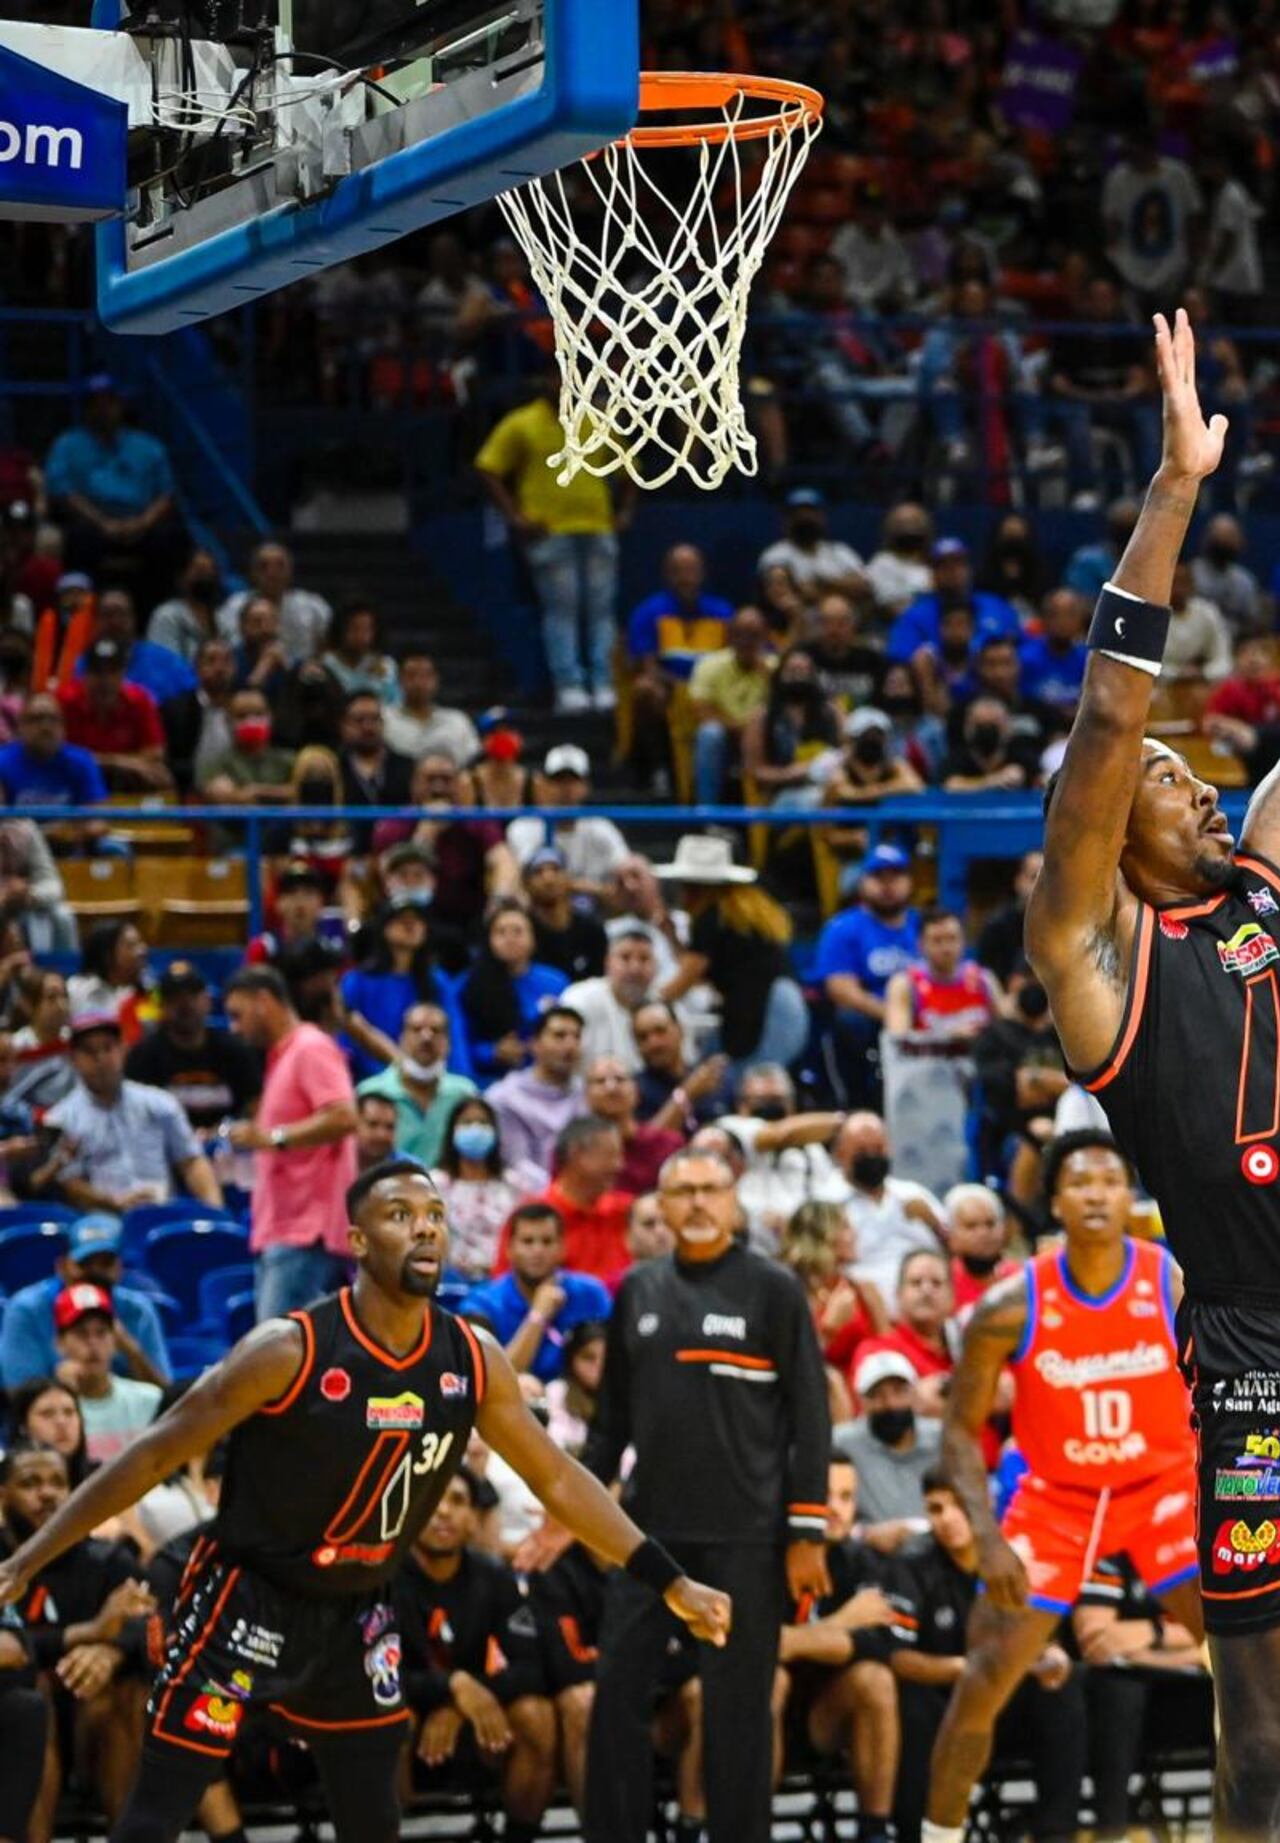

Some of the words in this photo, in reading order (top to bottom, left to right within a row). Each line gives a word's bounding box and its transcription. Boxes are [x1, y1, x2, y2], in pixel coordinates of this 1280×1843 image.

[1081, 1390, 1132, 1439] 10
[412, 1431, 454, 1475] 31
[1244, 1434, 1280, 1459] 50
